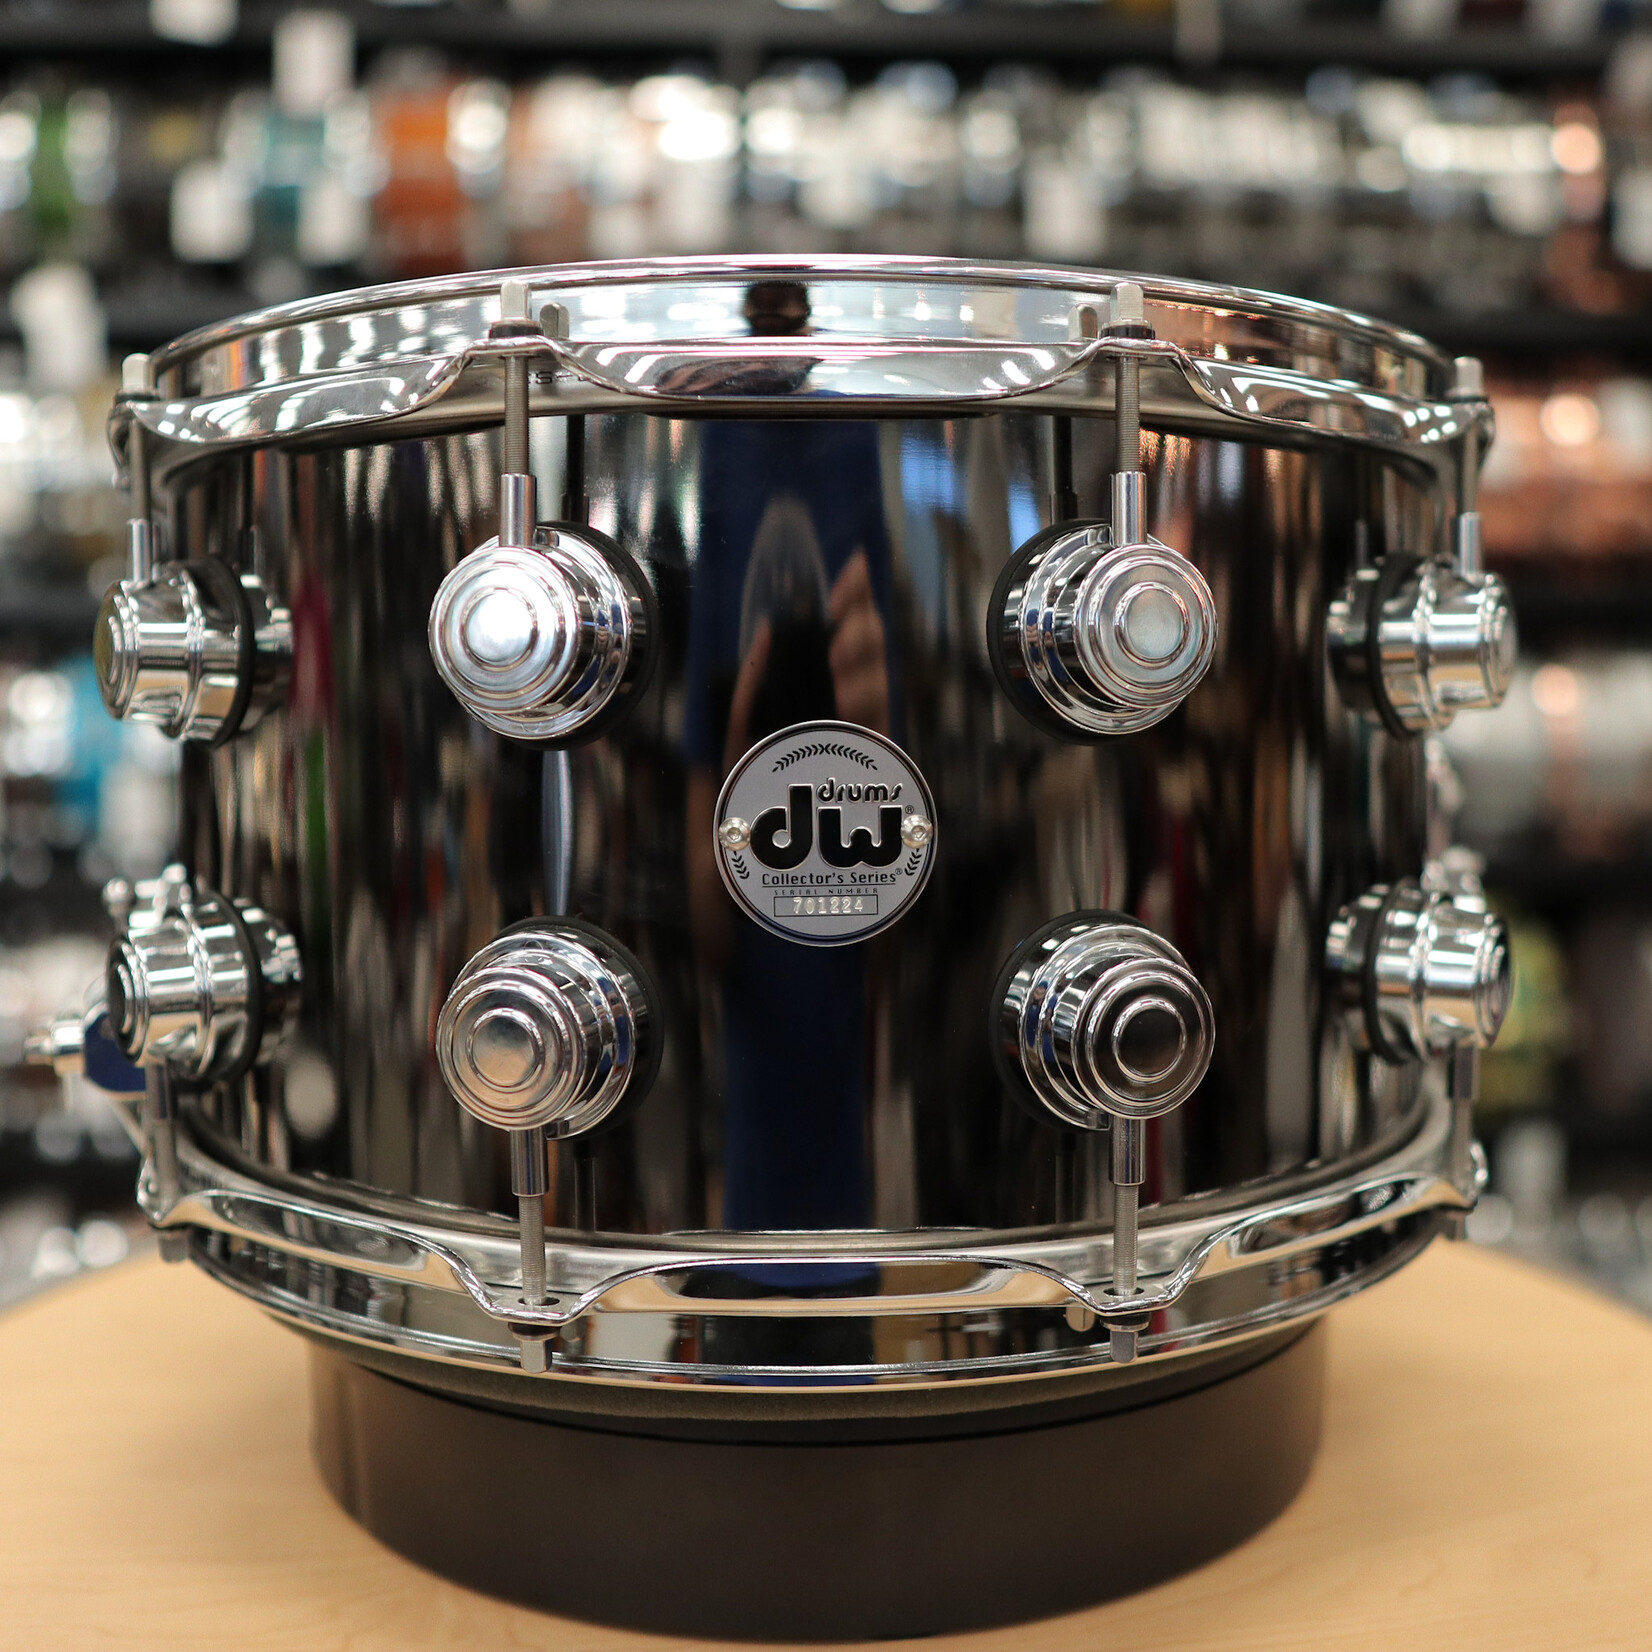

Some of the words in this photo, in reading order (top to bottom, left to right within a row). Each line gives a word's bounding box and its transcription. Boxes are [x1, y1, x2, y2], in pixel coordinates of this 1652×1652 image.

[816, 777, 903, 802] drums
[750, 783, 904, 870] dw
[761, 874, 844, 885] Collector's
[793, 896, 864, 914] 701224
